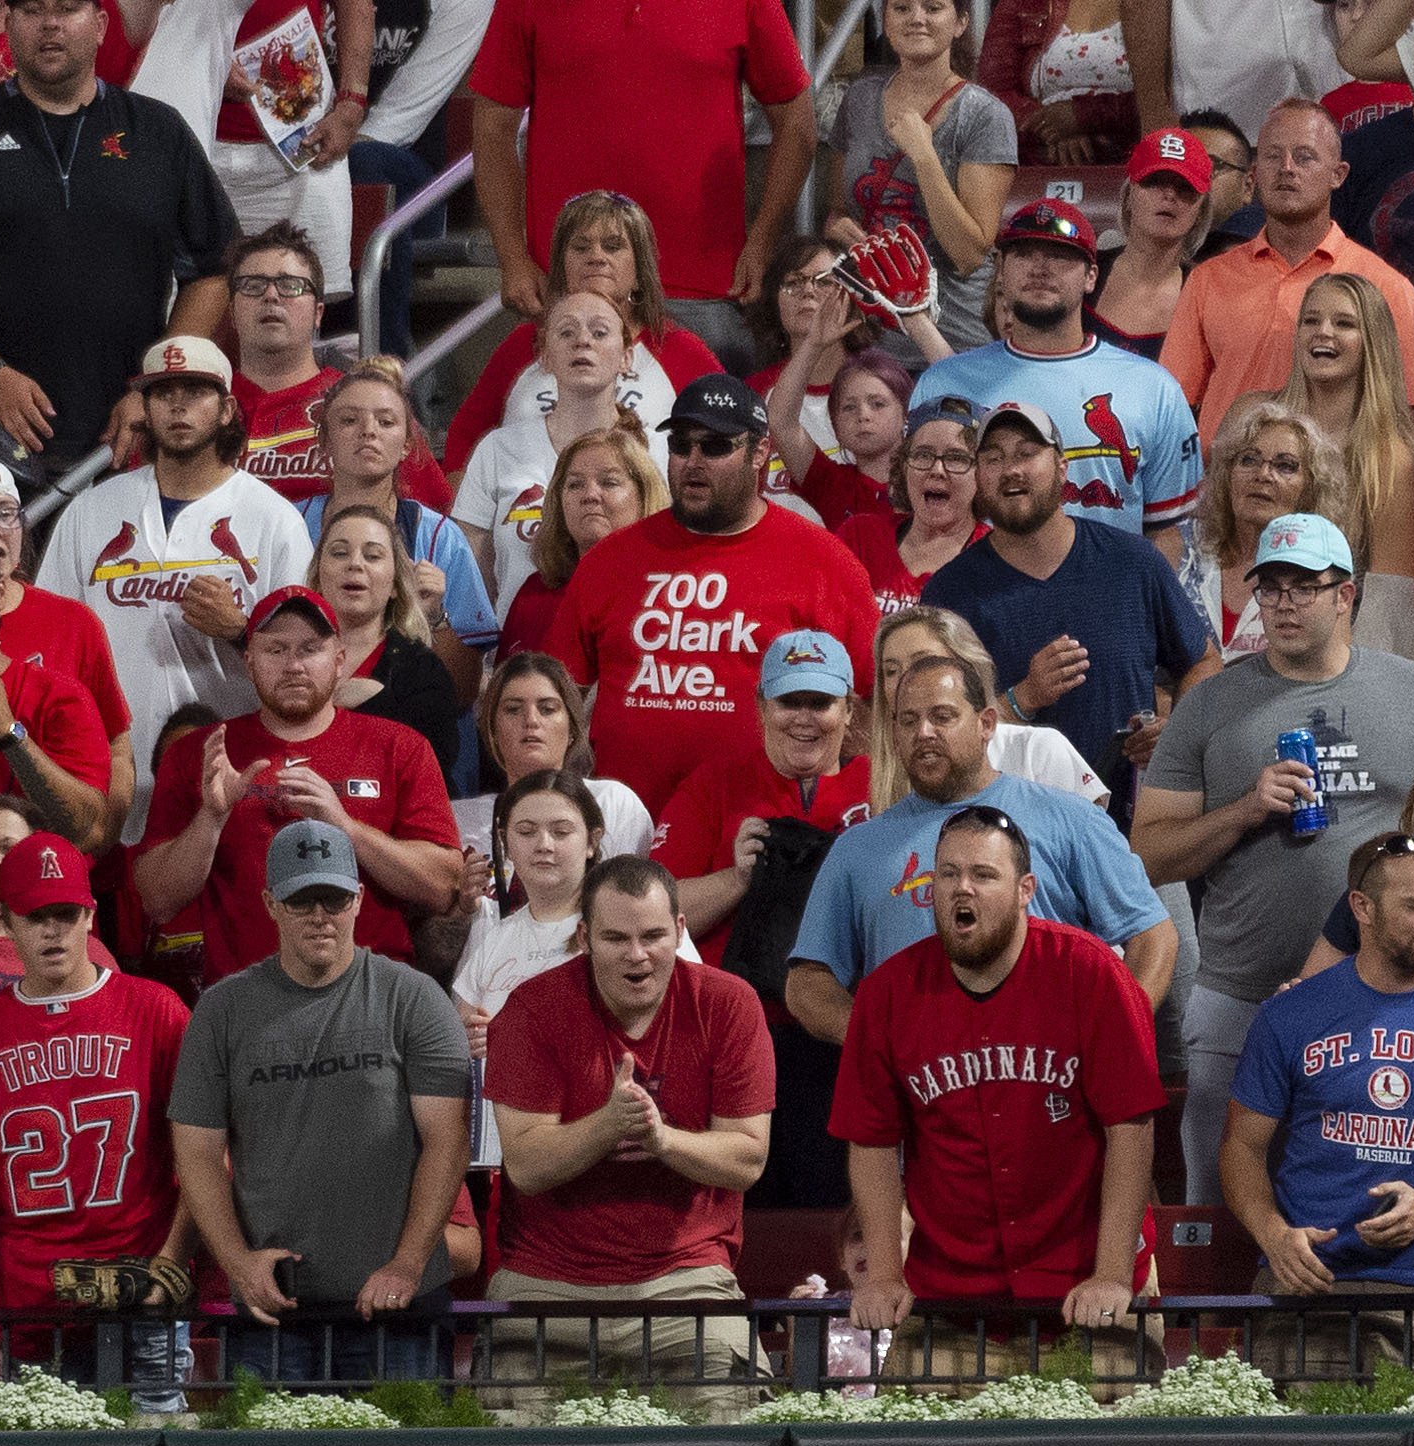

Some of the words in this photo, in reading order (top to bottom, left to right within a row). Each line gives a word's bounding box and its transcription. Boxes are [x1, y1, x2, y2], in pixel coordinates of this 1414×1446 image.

[643, 572, 728, 610] 700
[632, 609, 761, 654] Clark
[628, 654, 725, 698] Ave.
[623, 697, 638, 709] St.
[638, 697, 672, 711] Louis,
[674, 699, 697, 712] MO
[698, 700, 735, 713] 63102
[247, 1052, 384, 1087] ARMOUR
[1303, 1031, 1361, 1077] ST.
[907, 1044, 1080, 1107] CARDINALS
[0, 1089, 140, 1217] 27
[1355, 1146, 1413, 1165] BASEBALL
[1185, 1224, 1199, 1244] 8
